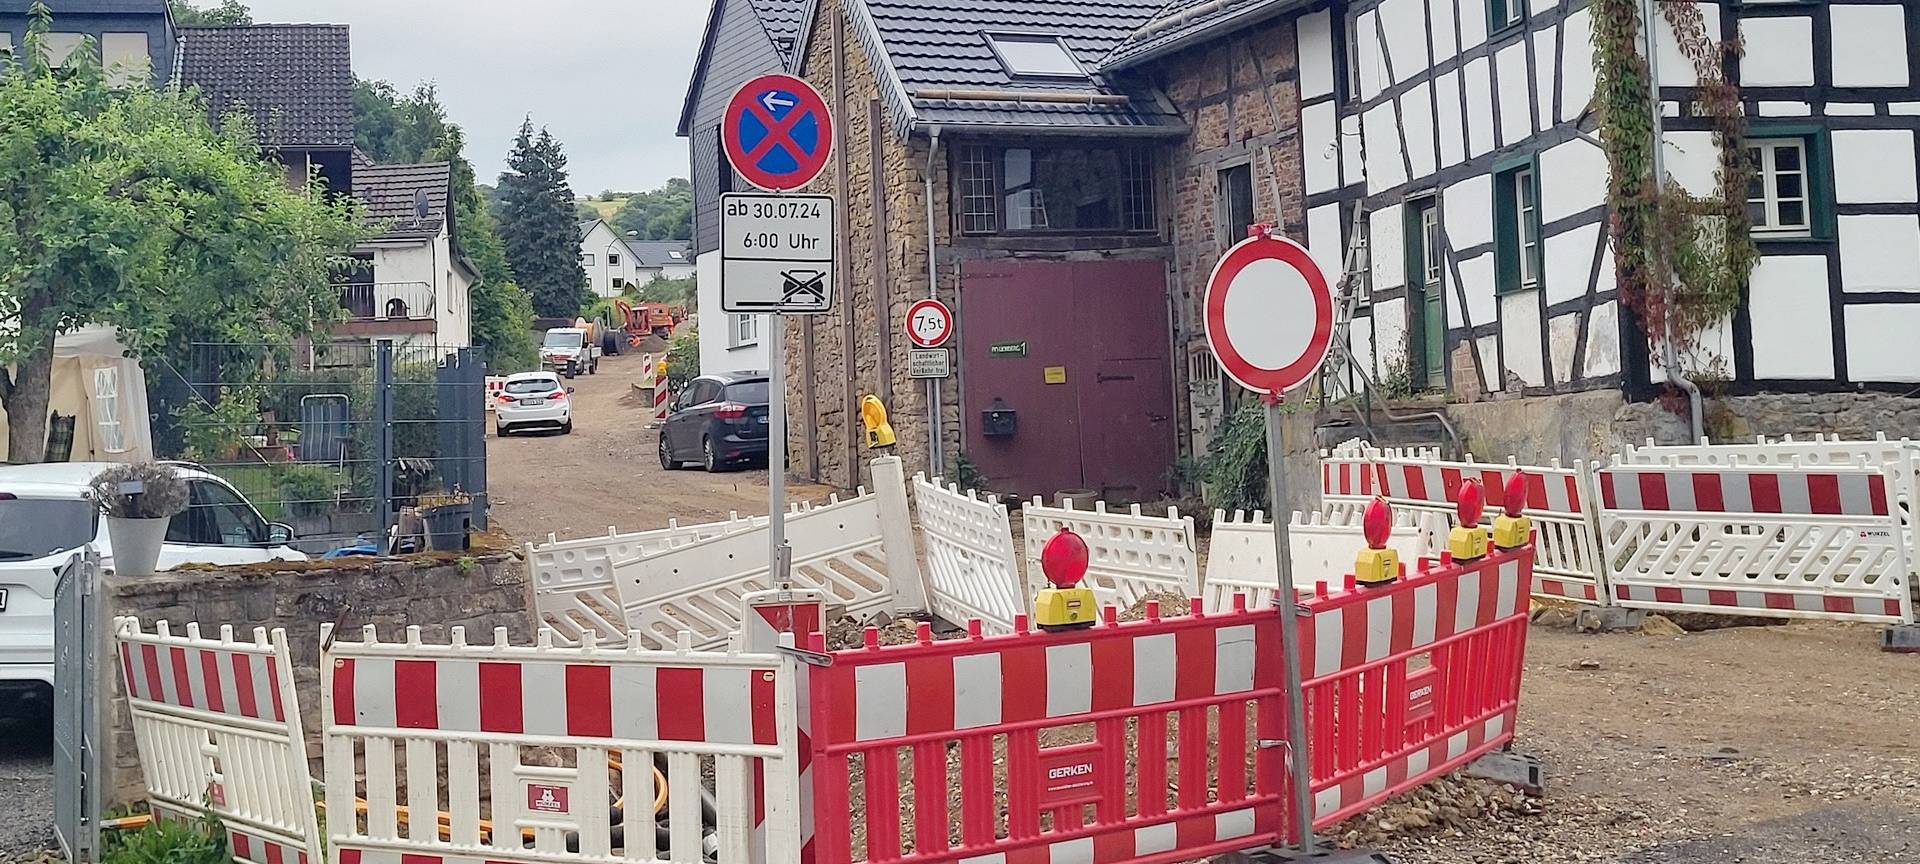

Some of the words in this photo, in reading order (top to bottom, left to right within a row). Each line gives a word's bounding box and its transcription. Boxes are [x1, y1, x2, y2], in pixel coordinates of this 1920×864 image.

[727, 199, 748, 216] ab
[753, 202, 821, 219] 30.07.24
[743, 232, 778, 248] 6:00
[789, 233, 820, 249] Uhr
[915, 315, 944, 333] 7,5t
[1020, 341, 1026, 356] 1
[1048, 763, 1093, 779] GERKEN
